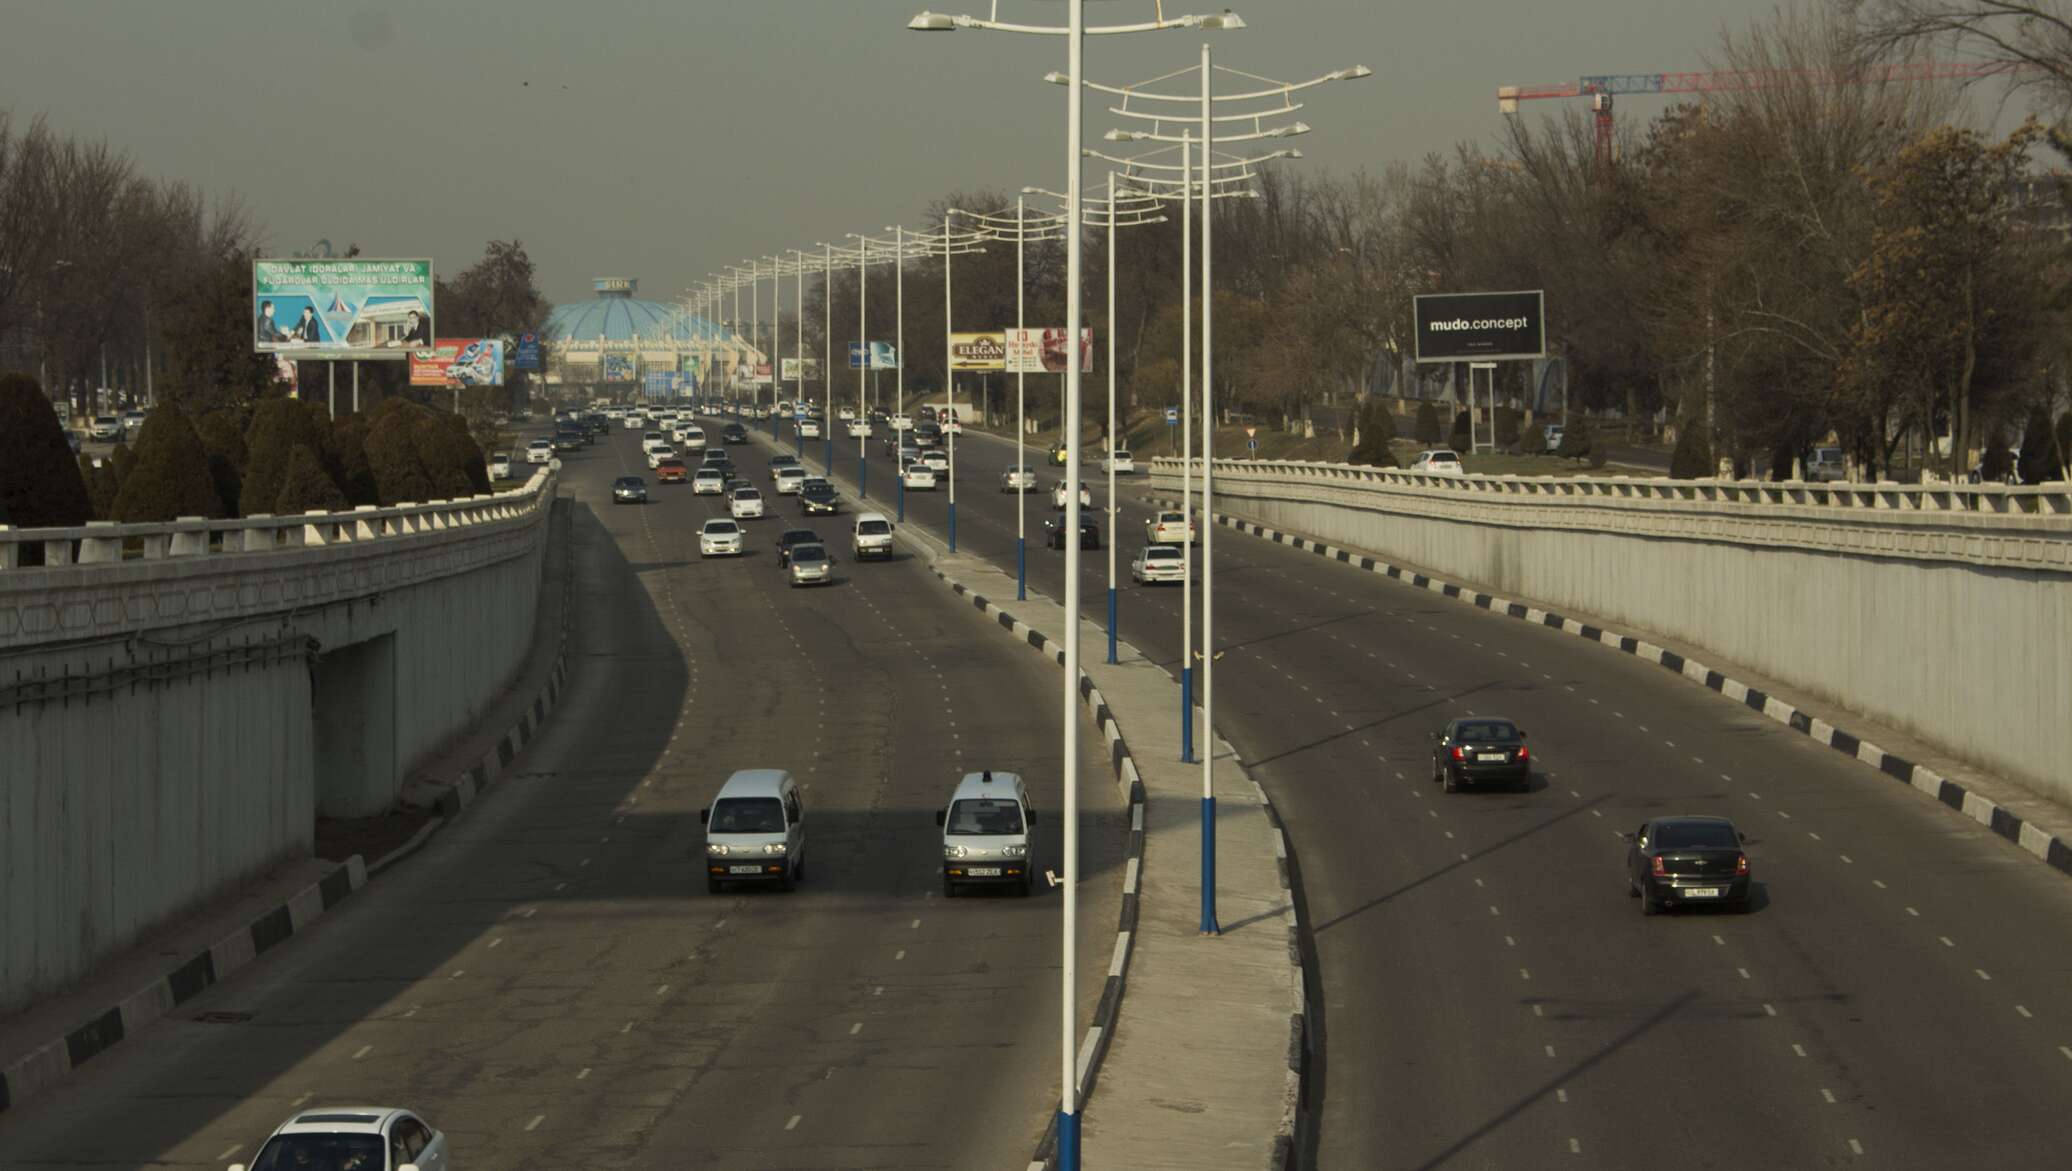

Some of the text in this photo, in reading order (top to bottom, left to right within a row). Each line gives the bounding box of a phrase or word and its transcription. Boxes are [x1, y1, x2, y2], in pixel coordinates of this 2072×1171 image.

[271, 265, 306, 273] DAVLAT
[361, 263, 400, 273] JAMIYAT
[403, 264, 416, 272] VA
[1430, 316, 1528, 331] mudo.concept
